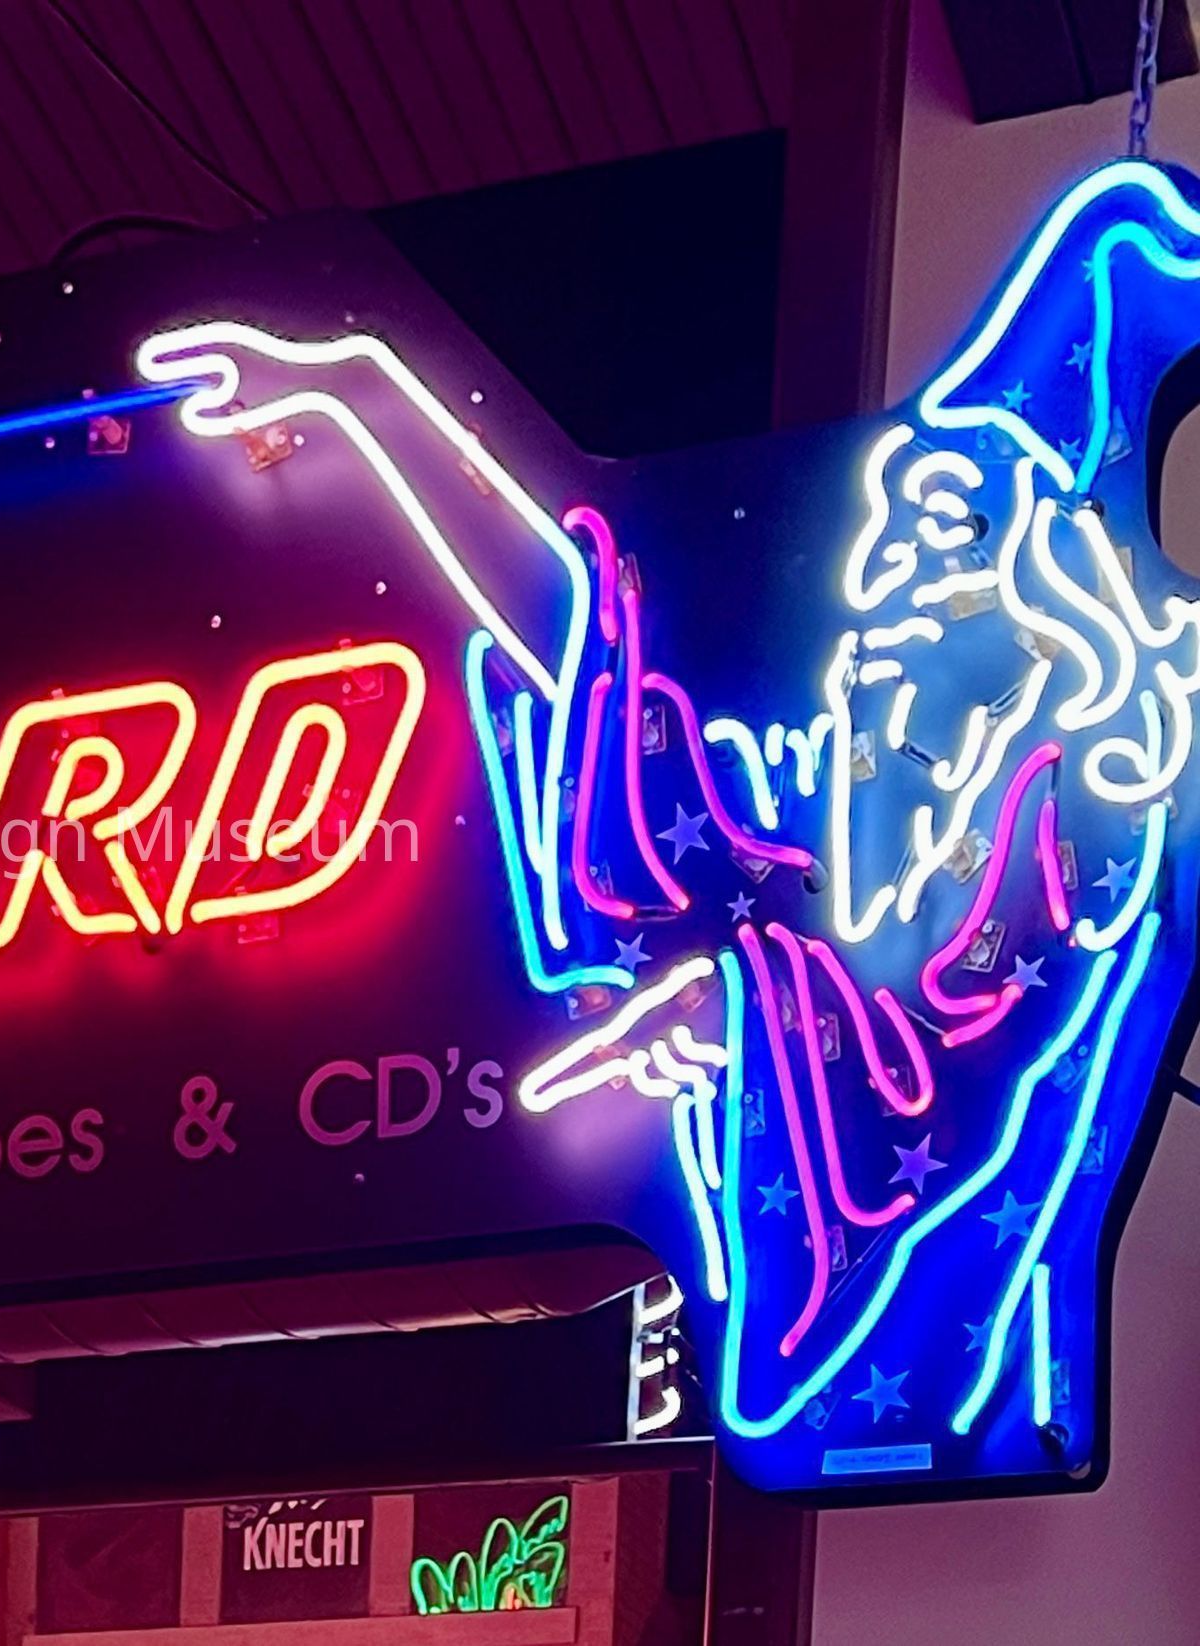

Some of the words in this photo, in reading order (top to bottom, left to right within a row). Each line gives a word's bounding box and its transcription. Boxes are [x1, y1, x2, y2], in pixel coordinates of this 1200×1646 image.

[173, 1074, 237, 1160] &
[298, 1047, 504, 1147] CD's
[243, 1516, 365, 1571] KNECHT
